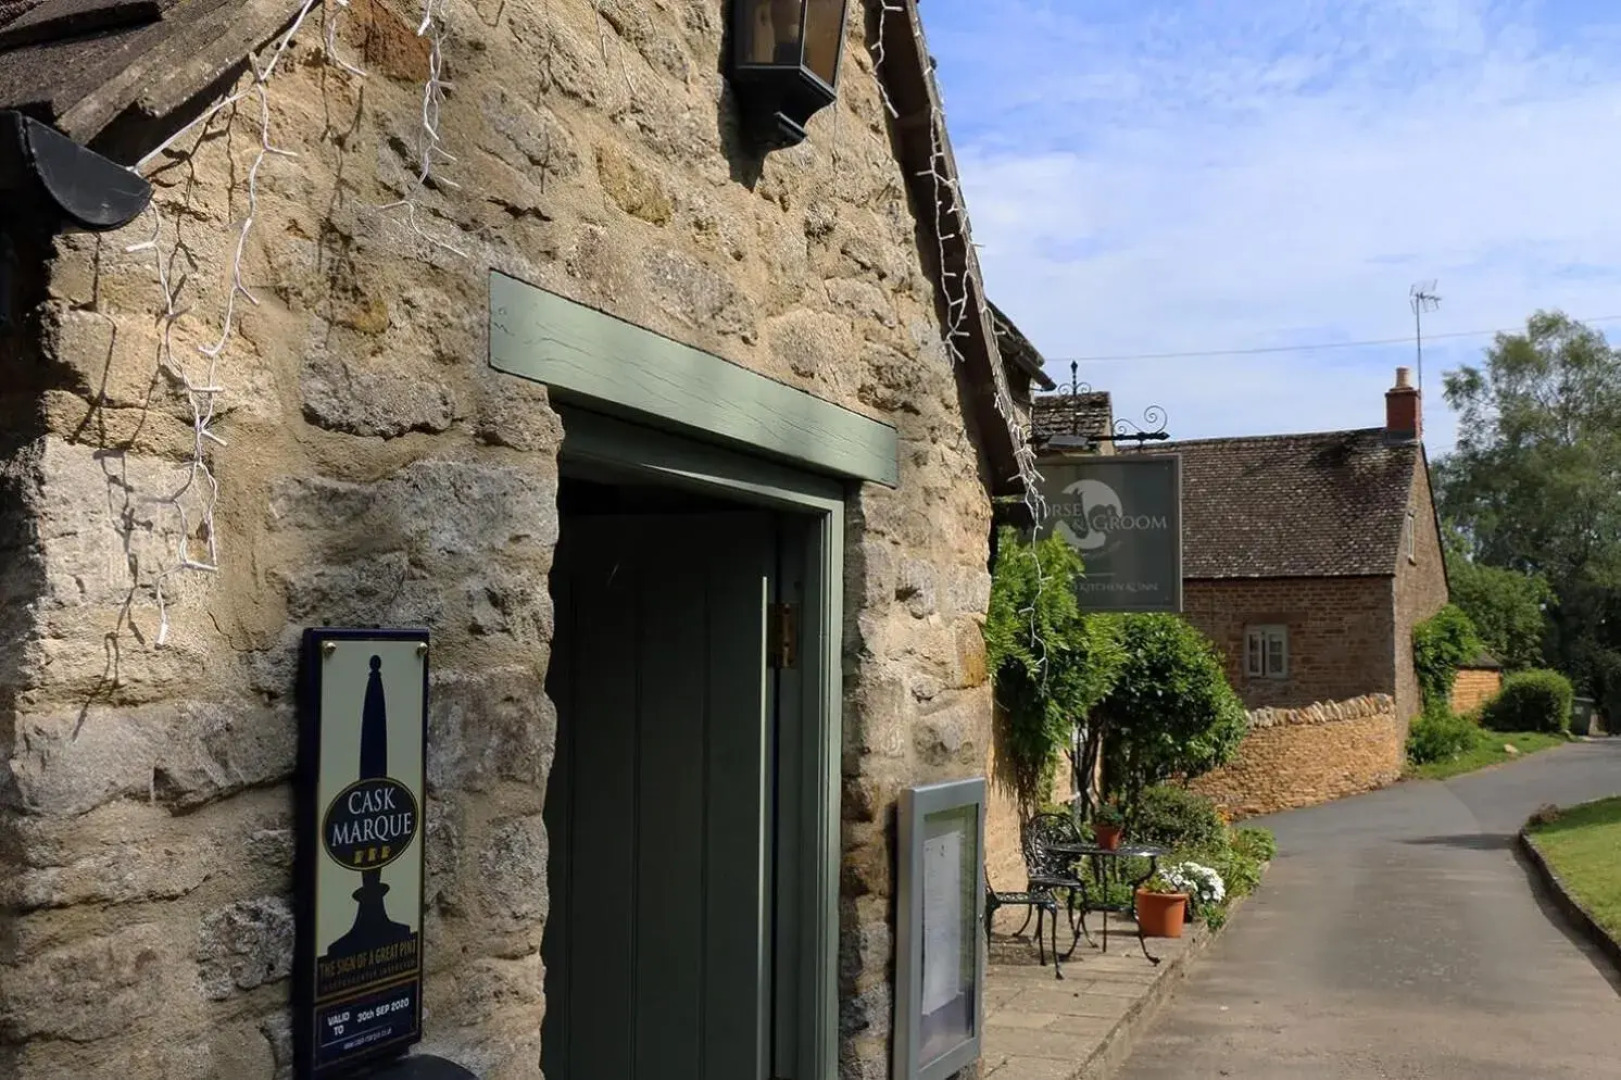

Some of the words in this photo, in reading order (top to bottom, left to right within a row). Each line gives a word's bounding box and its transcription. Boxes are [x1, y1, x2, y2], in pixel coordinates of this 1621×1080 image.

[1092, 515, 1167, 532] GROOM
[348, 787, 396, 815] CASK
[331, 812, 412, 847] MARQUE
[375, 942, 399, 963] GREAT
[327, 1011, 351, 1026] VALID
[356, 1010, 375, 1022] 30th
[375, 1004, 390, 1017] SEP
[391, 998, 409, 1011] 2020
[333, 1025, 344, 1036] TO
